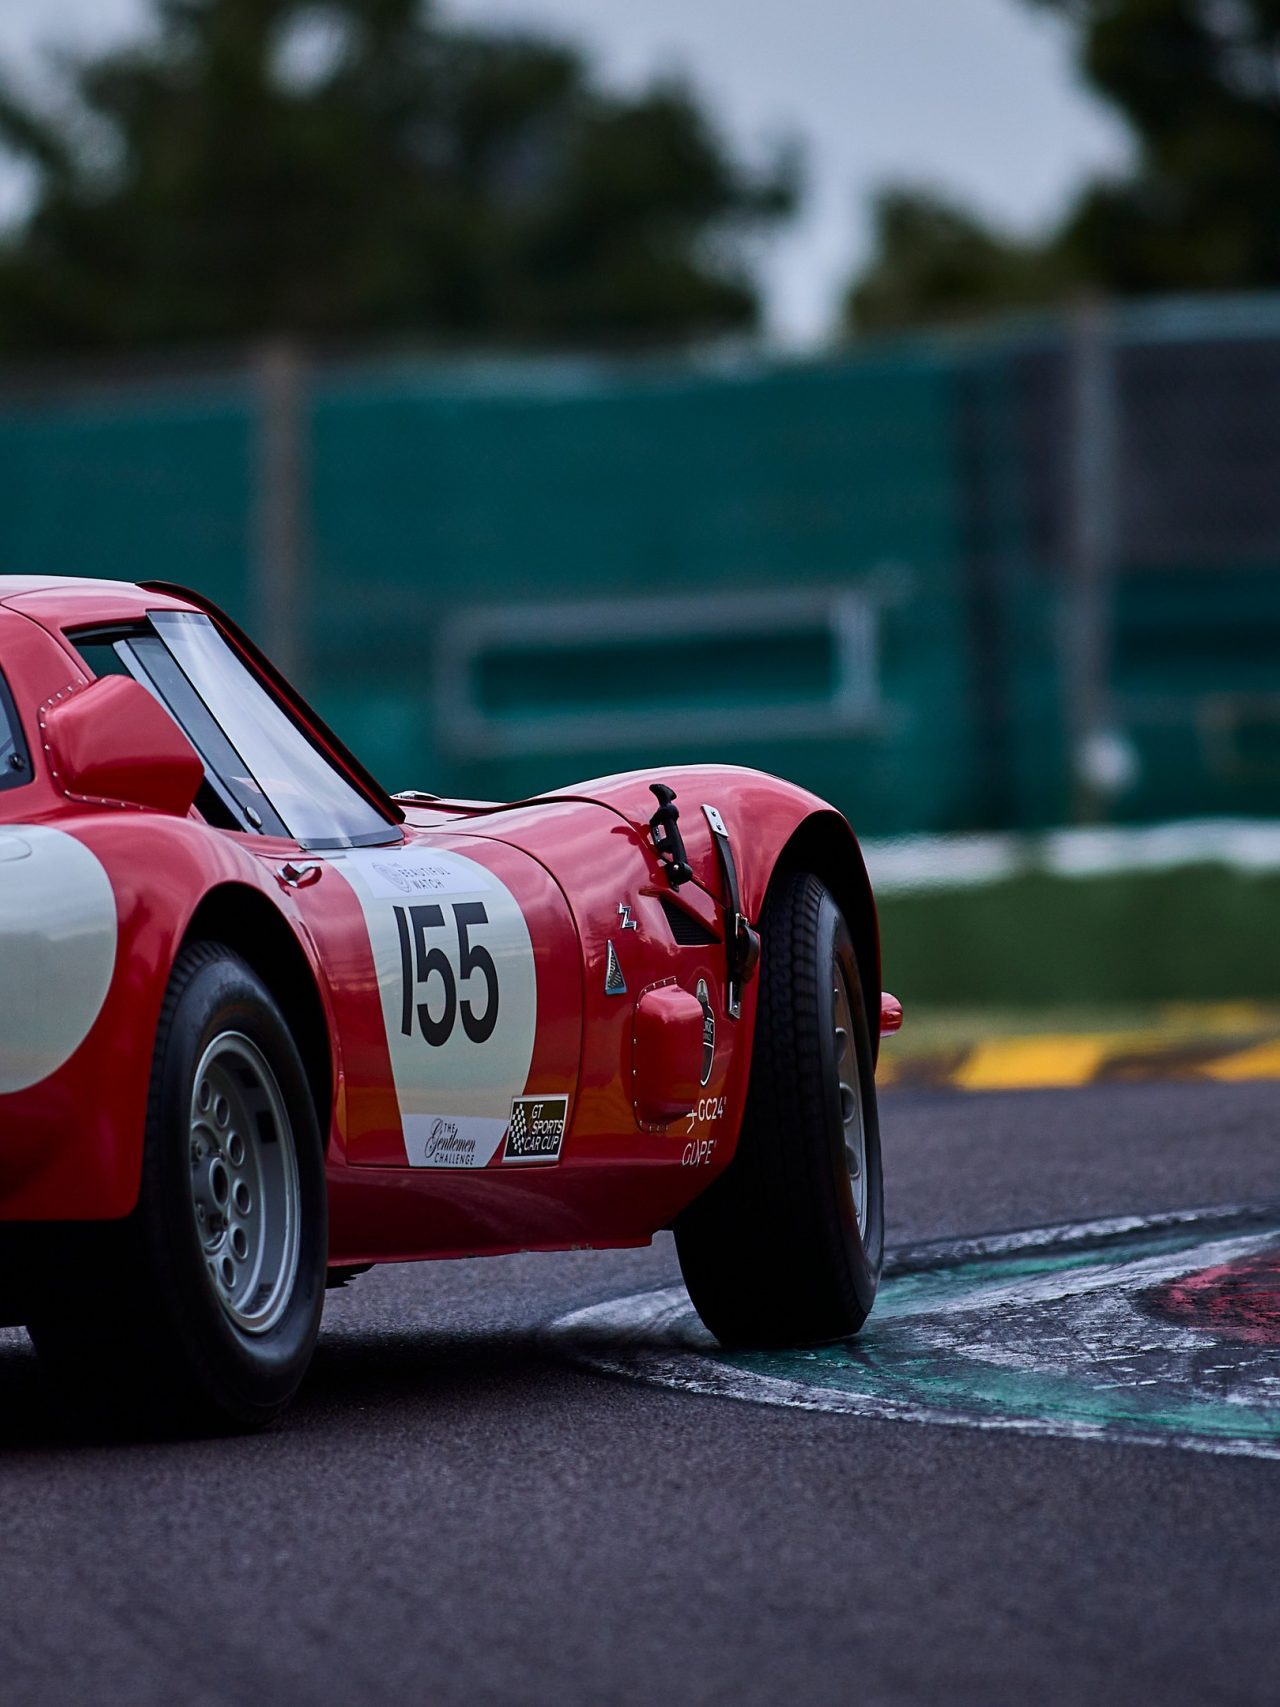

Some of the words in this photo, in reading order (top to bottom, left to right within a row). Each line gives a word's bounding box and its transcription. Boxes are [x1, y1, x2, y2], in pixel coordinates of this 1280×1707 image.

[398, 866, 452, 878] BEAUTIFUL
[412, 878, 446, 890] WATCH
[392, 901, 499, 1048] 155
[532, 1103, 544, 1119] GT
[443, 1122, 456, 1134] THE
[531, 1119, 563, 1136] SPORTS
[425, 1118, 476, 1158] Gentlemen
[524, 1136, 541, 1151] CAR
[541, 1135, 560, 1151] CUP
[434, 1152, 475, 1166] CHALLENGE
